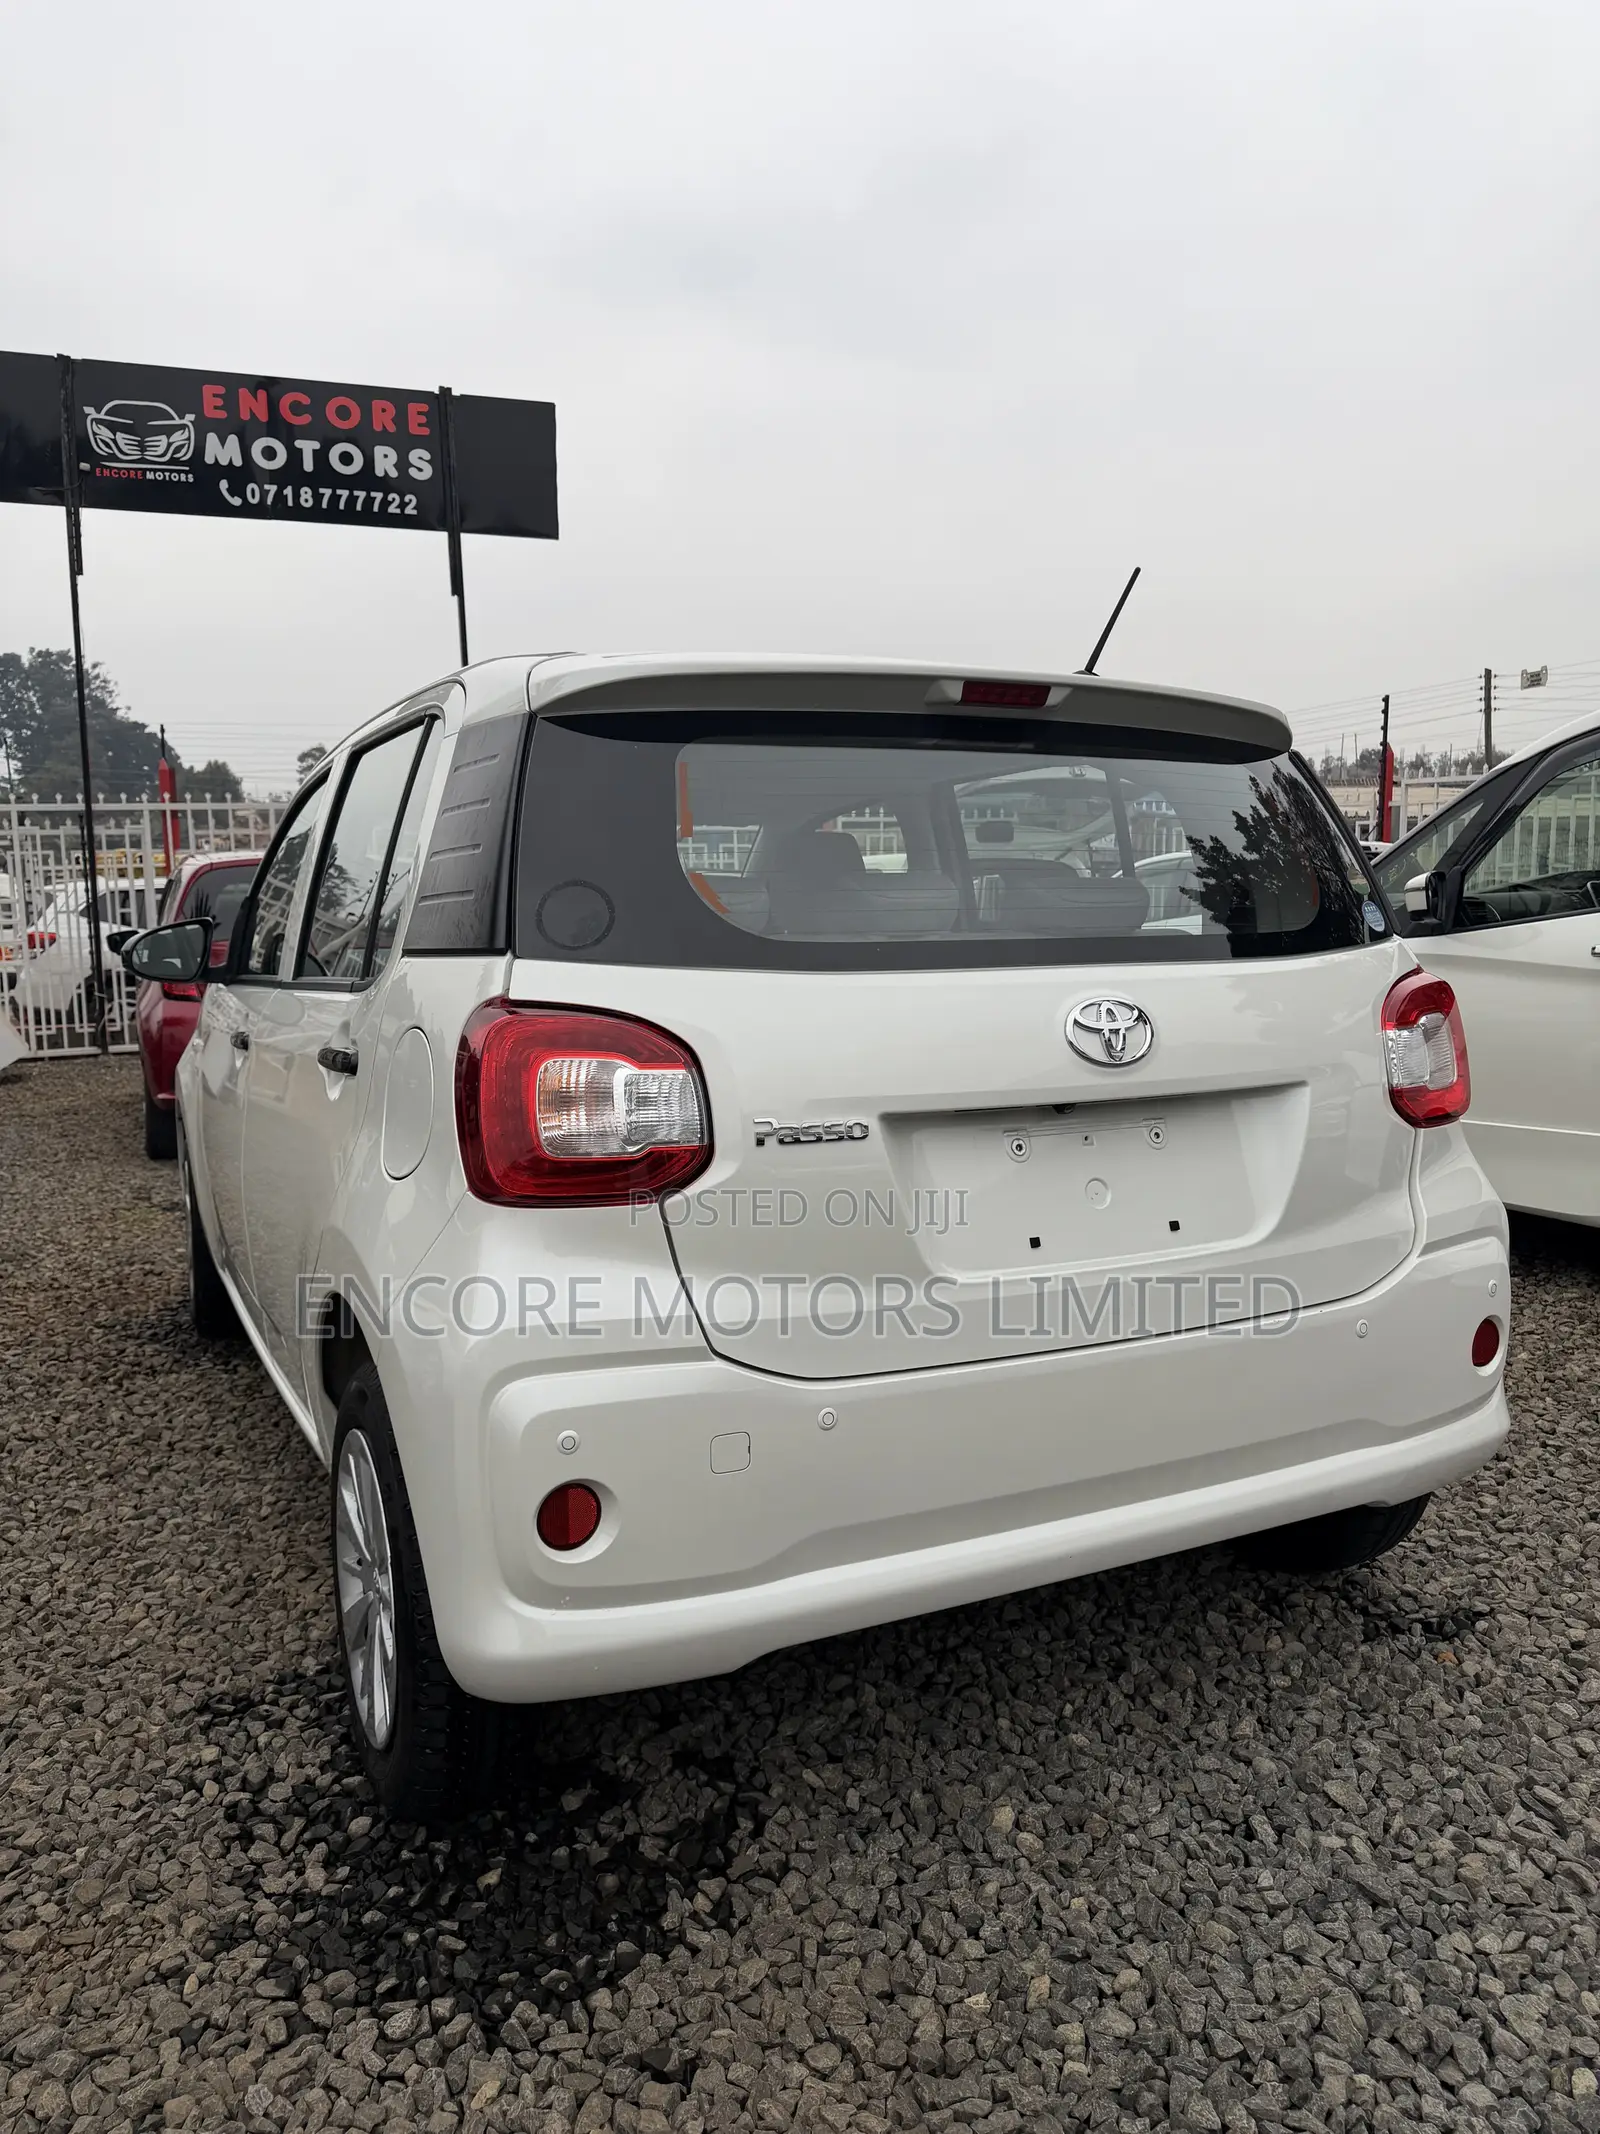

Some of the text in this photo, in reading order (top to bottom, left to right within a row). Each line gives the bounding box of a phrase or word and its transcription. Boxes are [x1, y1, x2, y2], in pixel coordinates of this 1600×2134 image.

[202, 384, 431, 436] ENCORE
[204, 432, 433, 481] MOTORS
[95, 467, 194, 483] ENCORE MOTORS
[246, 482, 418, 516] 0718777722
[753, 1117, 869, 1147] Passo
